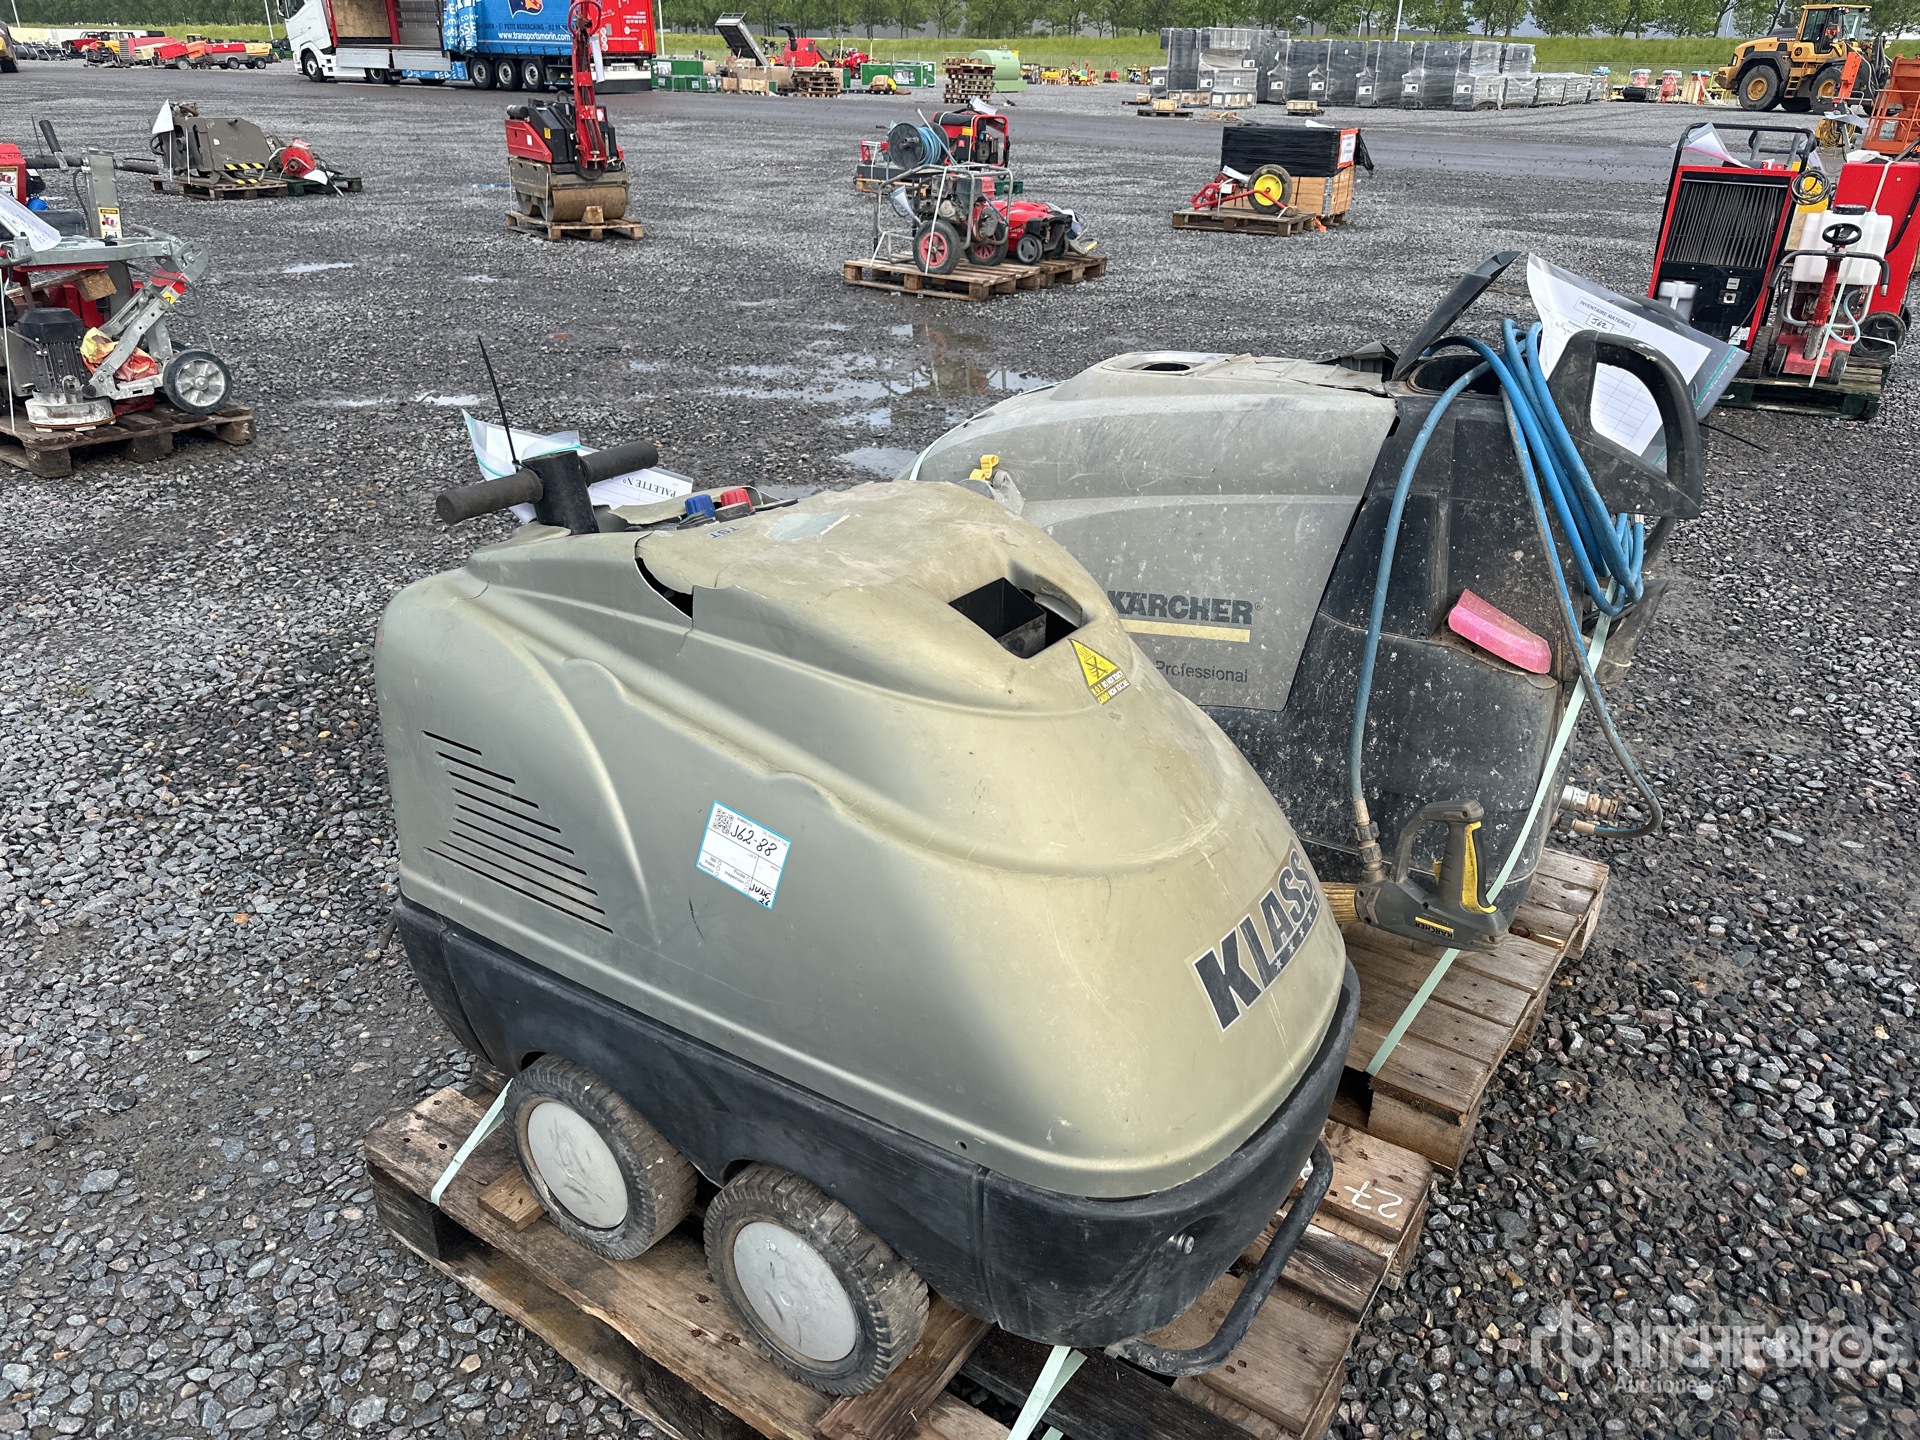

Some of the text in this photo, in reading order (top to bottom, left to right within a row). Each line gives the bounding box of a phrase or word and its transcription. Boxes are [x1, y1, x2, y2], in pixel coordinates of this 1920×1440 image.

[1579, 301, 1632, 329] INVENTAIRE MATERIEL
[636, 478, 676, 498] PALETTE
[1155, 660, 1248, 683] Professional
[730, 824, 778, 856] J62-88
[1192, 848, 1314, 1033] KLASS
